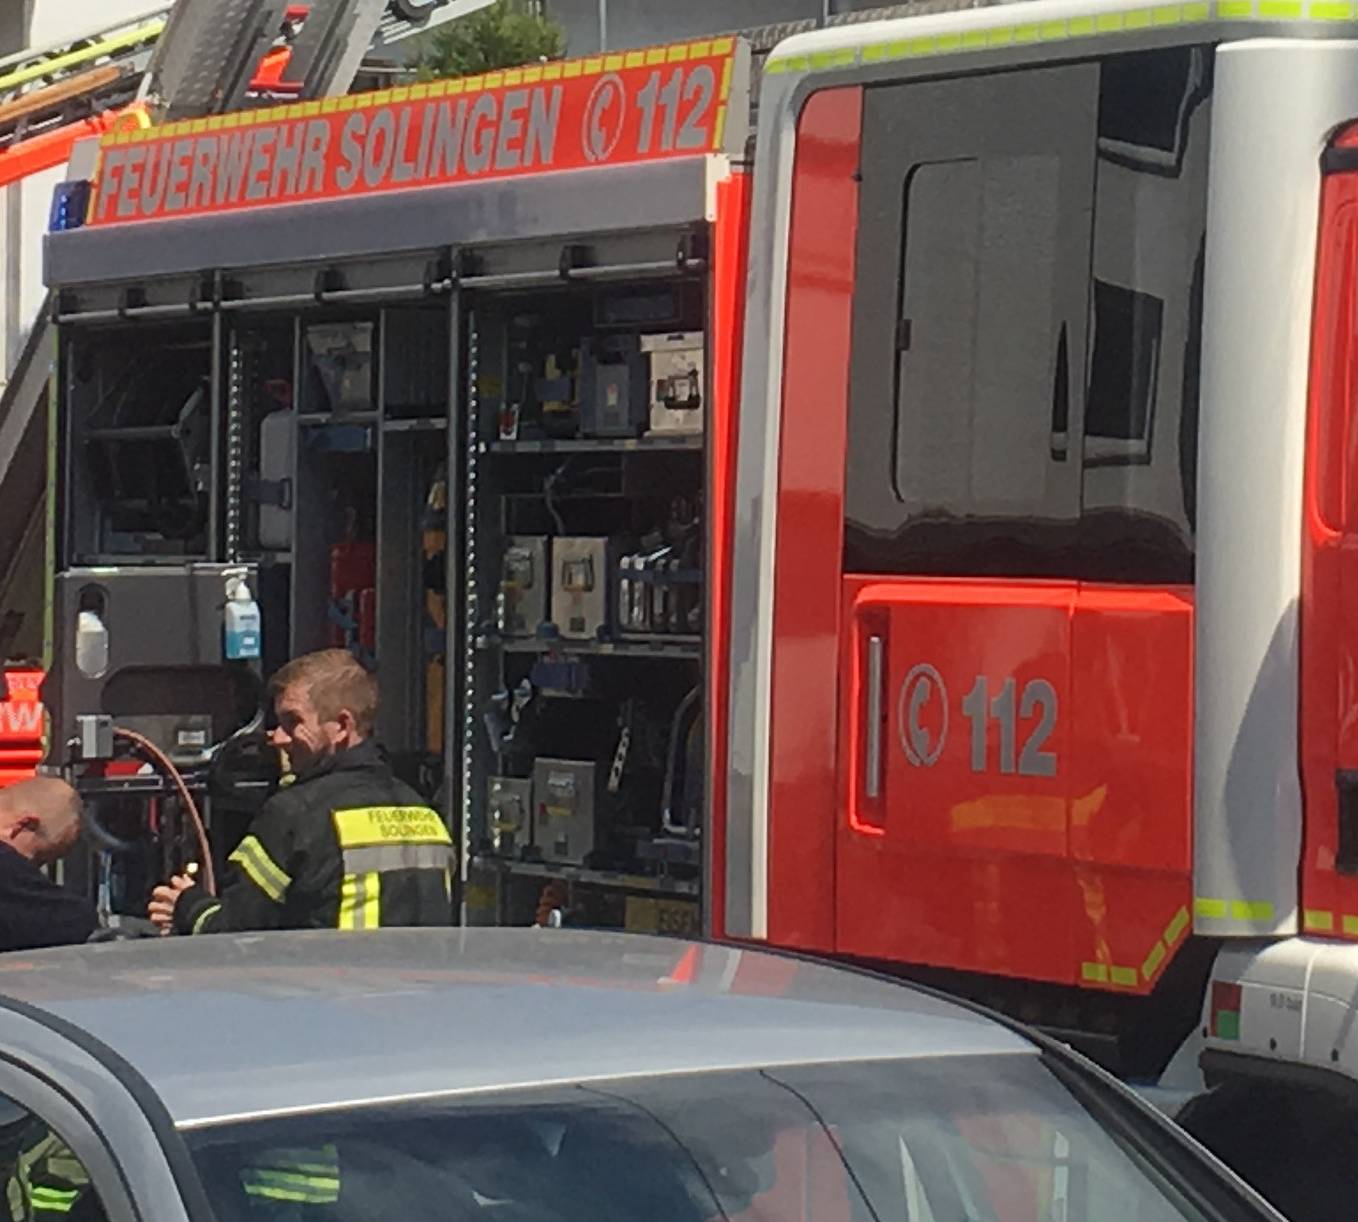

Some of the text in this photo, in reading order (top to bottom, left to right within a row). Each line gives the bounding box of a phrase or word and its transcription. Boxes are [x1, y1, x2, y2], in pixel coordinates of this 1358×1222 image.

[97, 65, 716, 219] FEUERWEHR SOLINGEN 112
[961, 674, 1058, 777] 112
